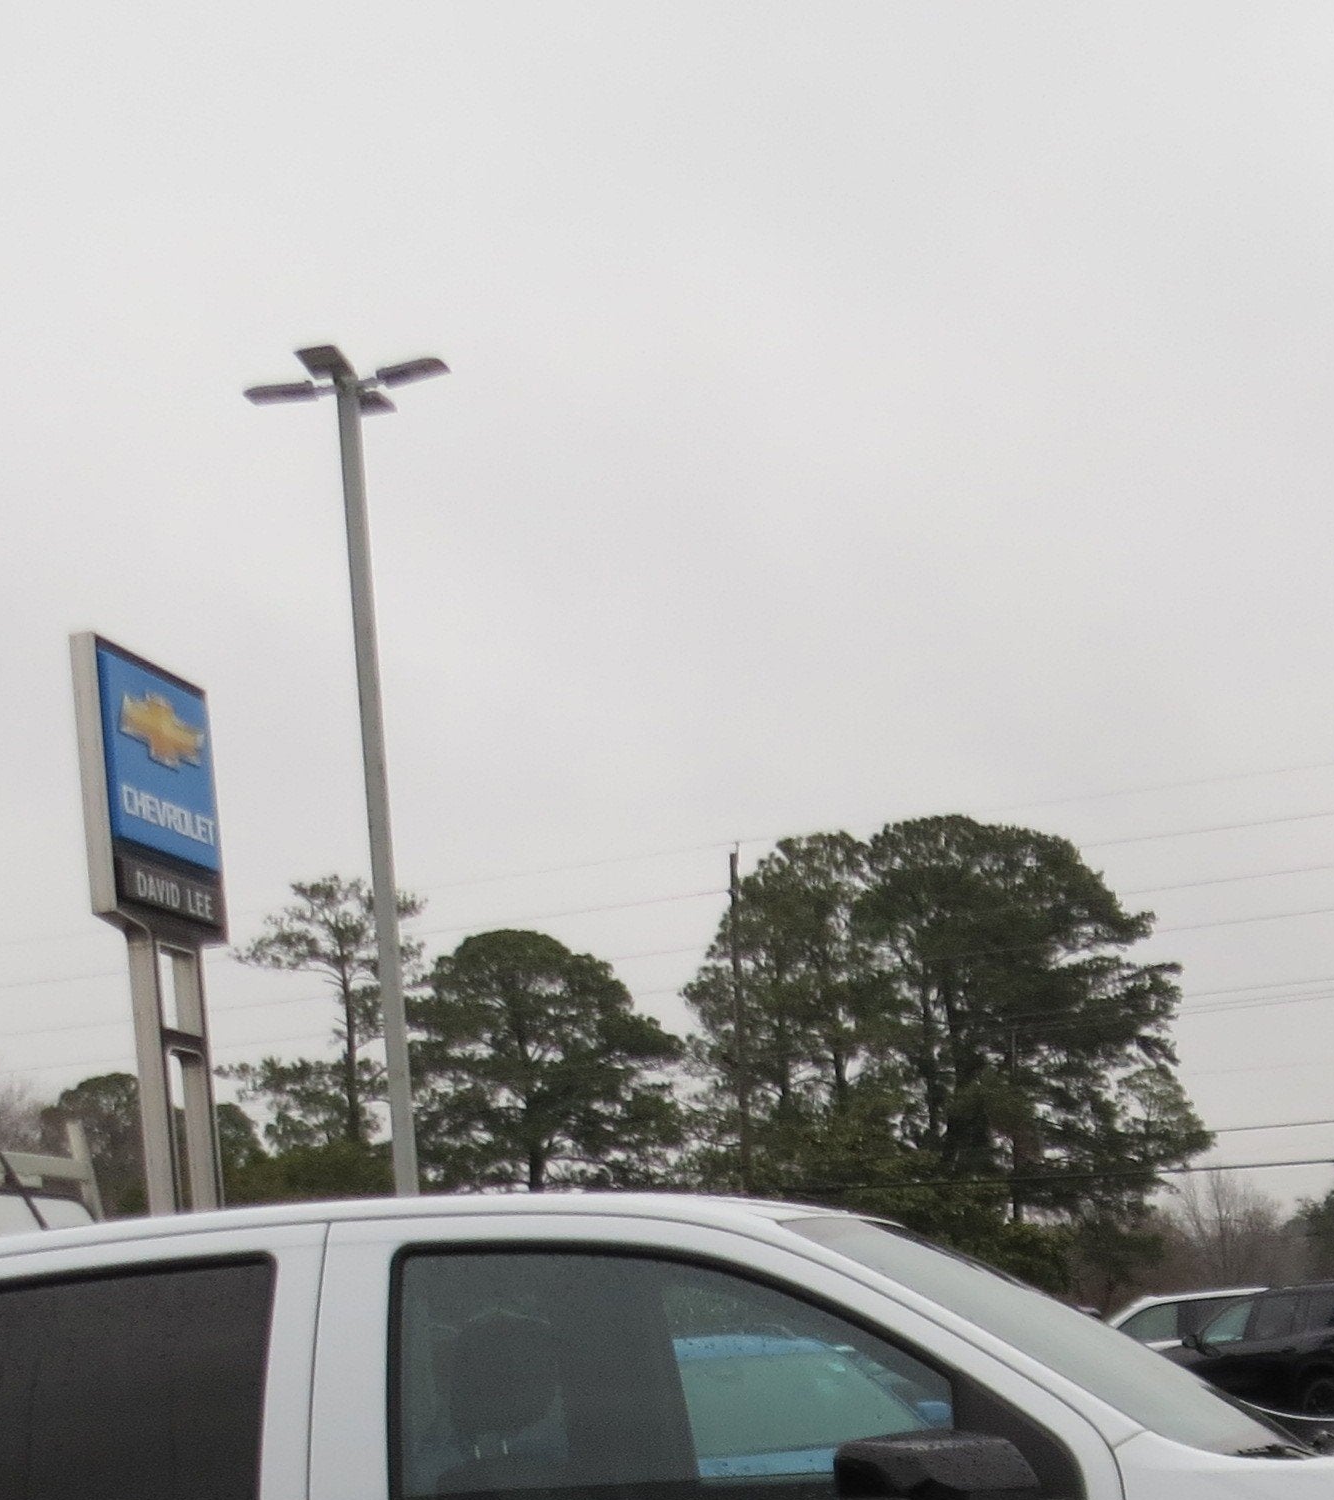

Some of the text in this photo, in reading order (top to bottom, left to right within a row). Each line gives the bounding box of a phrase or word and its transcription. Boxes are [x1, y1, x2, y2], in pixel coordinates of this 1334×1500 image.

[122, 784, 214, 845] CHEVROLET
[136, 871, 213, 920] DAVID LEE
